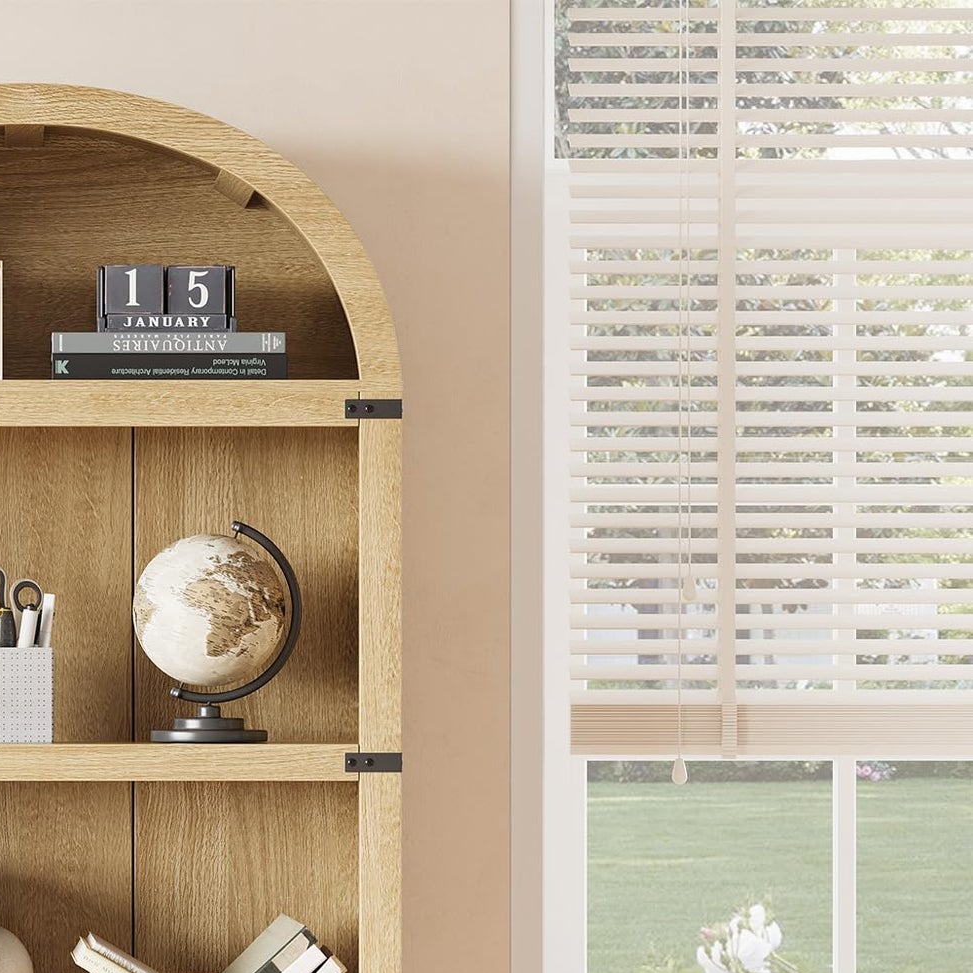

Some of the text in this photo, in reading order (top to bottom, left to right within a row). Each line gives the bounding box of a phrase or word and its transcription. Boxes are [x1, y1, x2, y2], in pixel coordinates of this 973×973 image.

[125, 268, 209, 308] 1 5
[123, 316, 211, 327] JANUARY
[113, 337, 228, 352] ANTIQUAIRES
[213, 358, 266, 367] Virginia McLeod
[111, 366, 267, 376] Detail in Contemporary Residential Architecture
